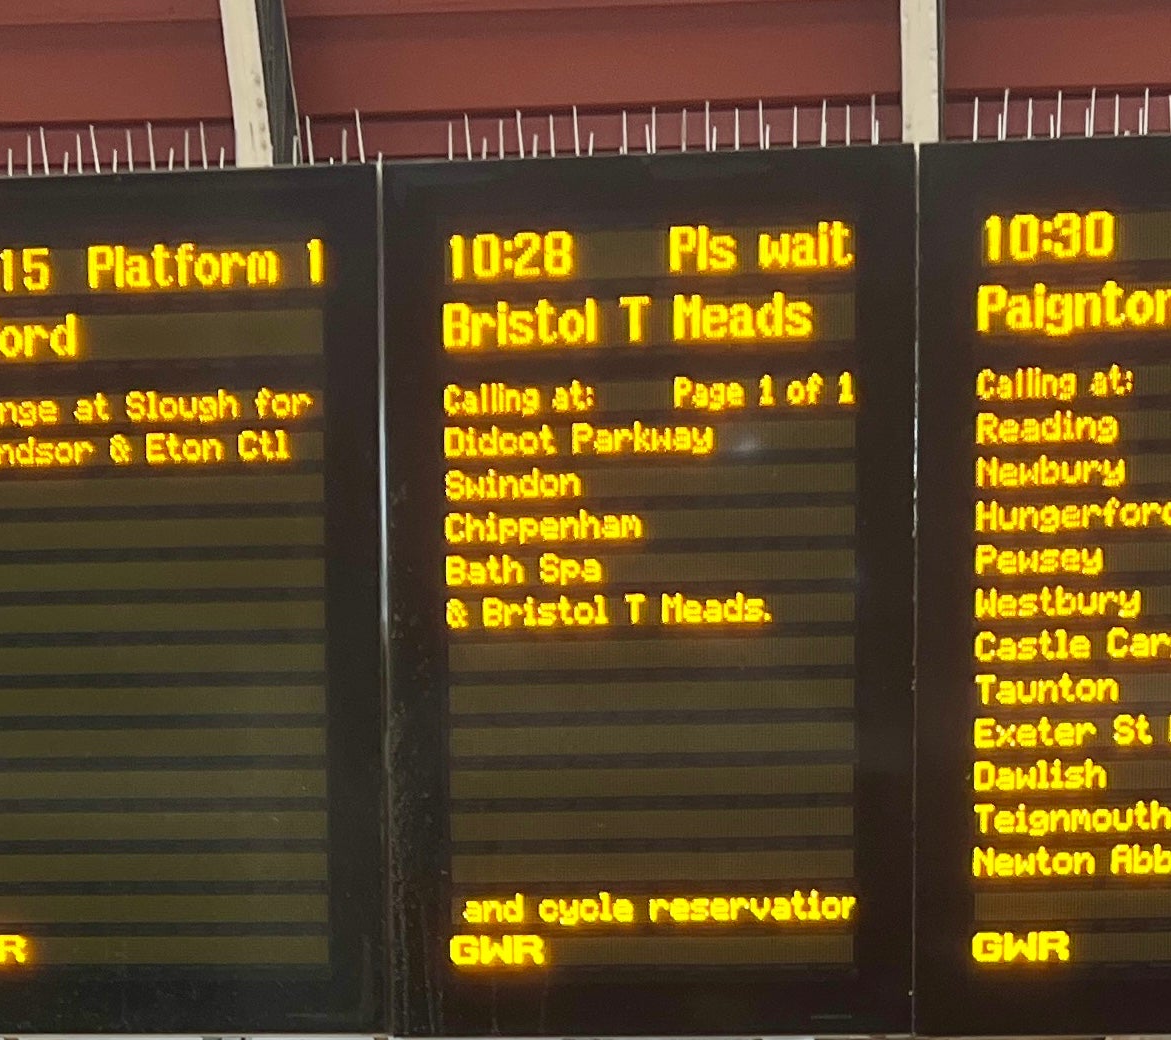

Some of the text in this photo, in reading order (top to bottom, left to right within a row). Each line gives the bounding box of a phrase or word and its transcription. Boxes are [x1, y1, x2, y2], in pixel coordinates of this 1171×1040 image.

[450, 221, 853, 281] 10:28 Pls wait
[986, 211, 1114, 263] 10:30
[88, 243, 280, 290] Platform
[307, 239, 323, 284] 1
[443, 292, 812, 349] Bristol T Meads
[74, 393, 109, 423] at
[126, 389, 240, 423] Slough
[255, 388, 313, 419] for
[444, 421, 713, 458] Didcot Parkway
[976, 410, 1118, 445] Reading
[110, 434, 132, 463] &
[146, 433, 224, 463] Eton
[238, 430, 290, 461] Ctl
[445, 468, 581, 501] Swindon
[976, 455, 1125, 487] Newbury
[445, 509, 642, 544] Chippenham
[446, 553, 602, 586] Bath Spa
[976, 545, 1103, 575] Pewsey
[446, 592, 771, 628] & Bristol T Meads.
[975, 586, 1141, 619] Westbury
[975, 629, 1091, 662] Castle
[976, 673, 1119, 705] Taunton
[974, 717, 1096, 748] Exeter
[1113, 715, 1152, 745] St
[974, 759, 1106, 792] Dawlish
[974, 801, 1171, 836] Teignmouth
[973, 846, 1095, 877] Newton
[463, 893, 525, 924] and
[539, 892, 634, 926] cycle
[450, 935, 546, 966] GWR
[972, 931, 1069, 962] GWR
